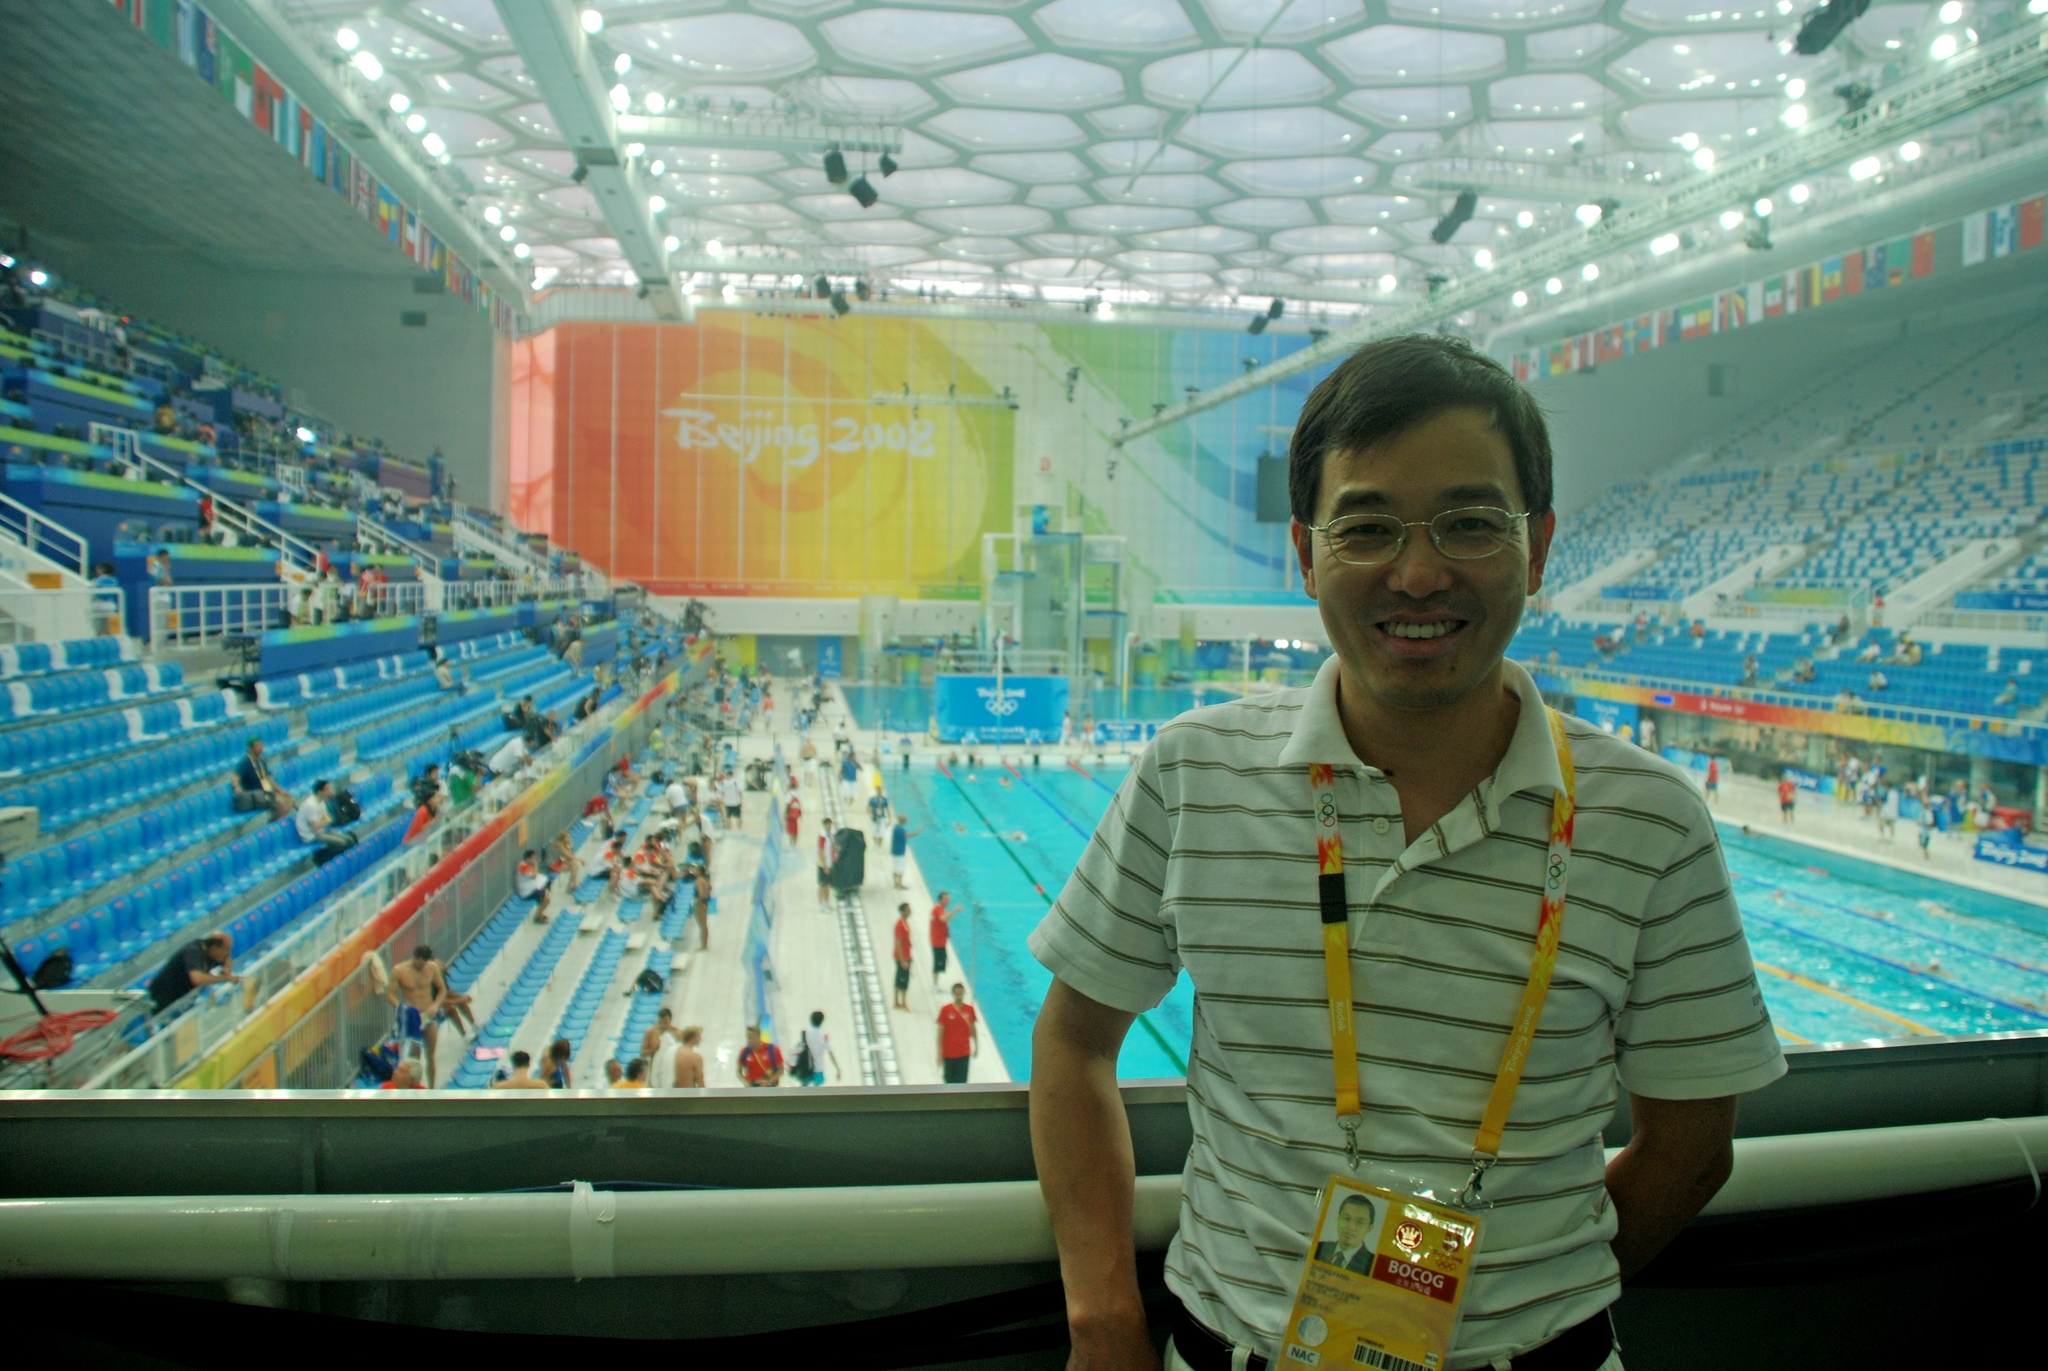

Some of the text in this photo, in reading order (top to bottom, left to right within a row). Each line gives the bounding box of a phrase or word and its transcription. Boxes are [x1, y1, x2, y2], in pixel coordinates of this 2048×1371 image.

[660, 408, 936, 468] Beijing 2008
[1336, 1001, 1346, 1031] Kodak
[1504, 1005, 1536, 1074] Beijing 2008
[1388, 1260, 1445, 1289] BOCOG
[1291, 1346, 1316, 1362] NAC
